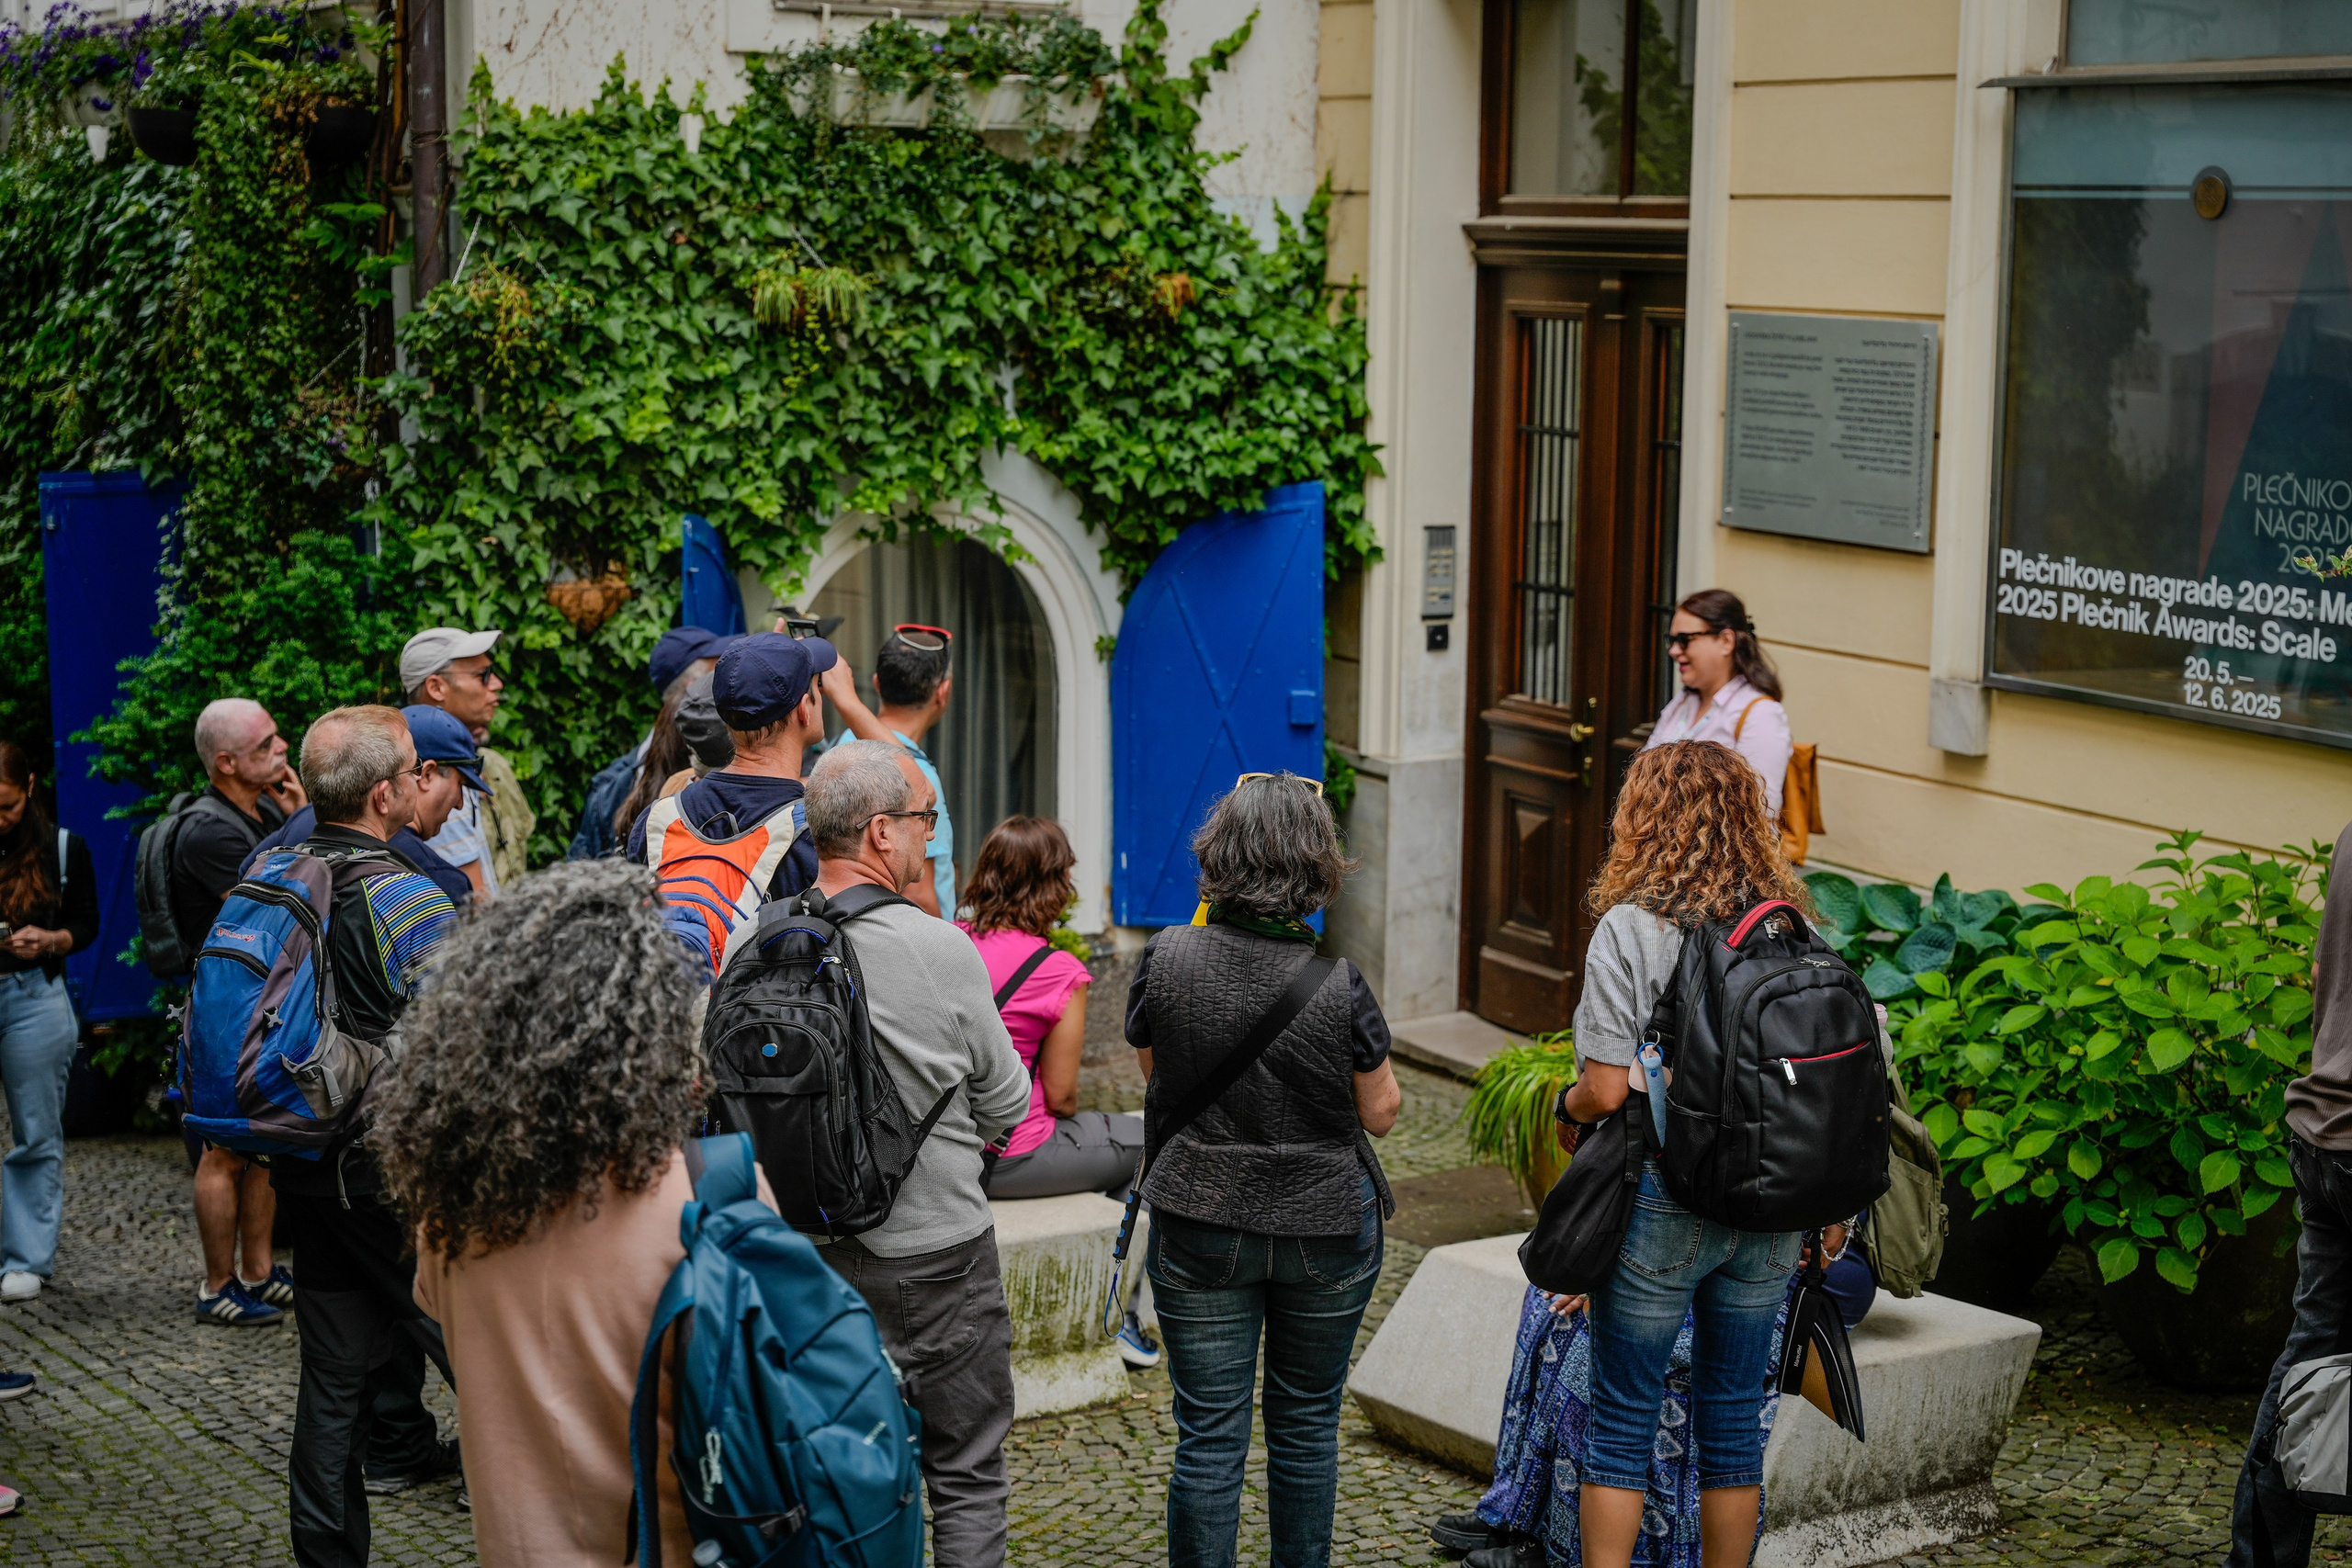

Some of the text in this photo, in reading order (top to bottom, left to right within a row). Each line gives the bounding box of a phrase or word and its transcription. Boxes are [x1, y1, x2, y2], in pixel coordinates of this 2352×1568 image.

[2244, 471, 2352, 511] PLEČNIKO
[2255, 507, 2352, 545] NAGRAD
[1998, 547, 2126, 595] Plečnikove
[2129, 573, 2233, 610] nagrade
[2237, 580, 2314, 621] 2025:
[1997, 583, 2337, 662] 2025 Plečnik Awards: Scale
[2231, 689, 2281, 720] 2025
